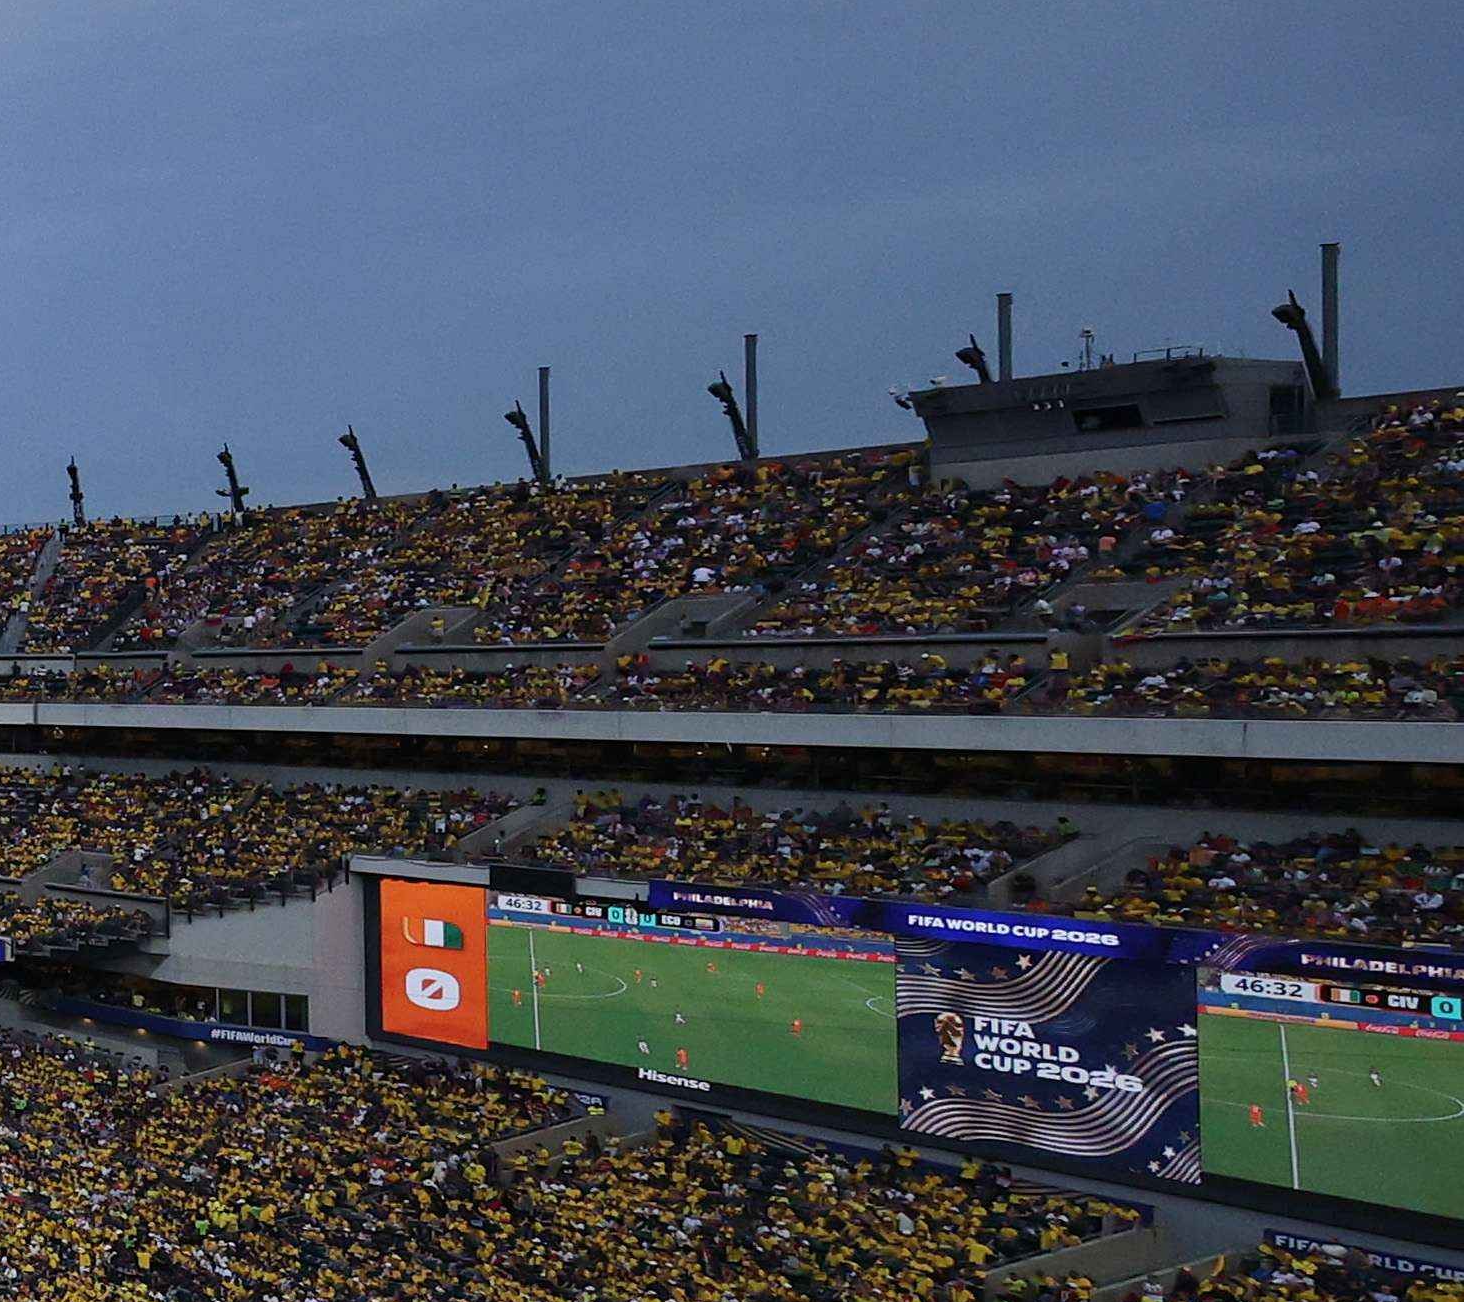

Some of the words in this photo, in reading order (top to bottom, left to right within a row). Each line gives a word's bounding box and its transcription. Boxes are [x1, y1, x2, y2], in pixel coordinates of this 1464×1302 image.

[505, 897, 543, 912] 46:32
[673, 892, 774, 911] PHILADELPHIA
[908, 915, 945, 929] FIFA
[945, 918, 1010, 935] WORLD
[1012, 925, 1049, 939] CUP
[1051, 929, 1120, 946] 2026
[1300, 953, 1464, 980] PHILADELPHIA
[1234, 977, 1303, 998] 46:32
[1387, 994, 1420, 1010] CIV
[973, 1017, 1036, 1040] FIFA
[973, 1033, 1080, 1063] WORLD
[638, 1067, 711, 1092] Hisense
[974, 1053, 1033, 1075] CUP
[1036, 1061, 1144, 1093] 2026
